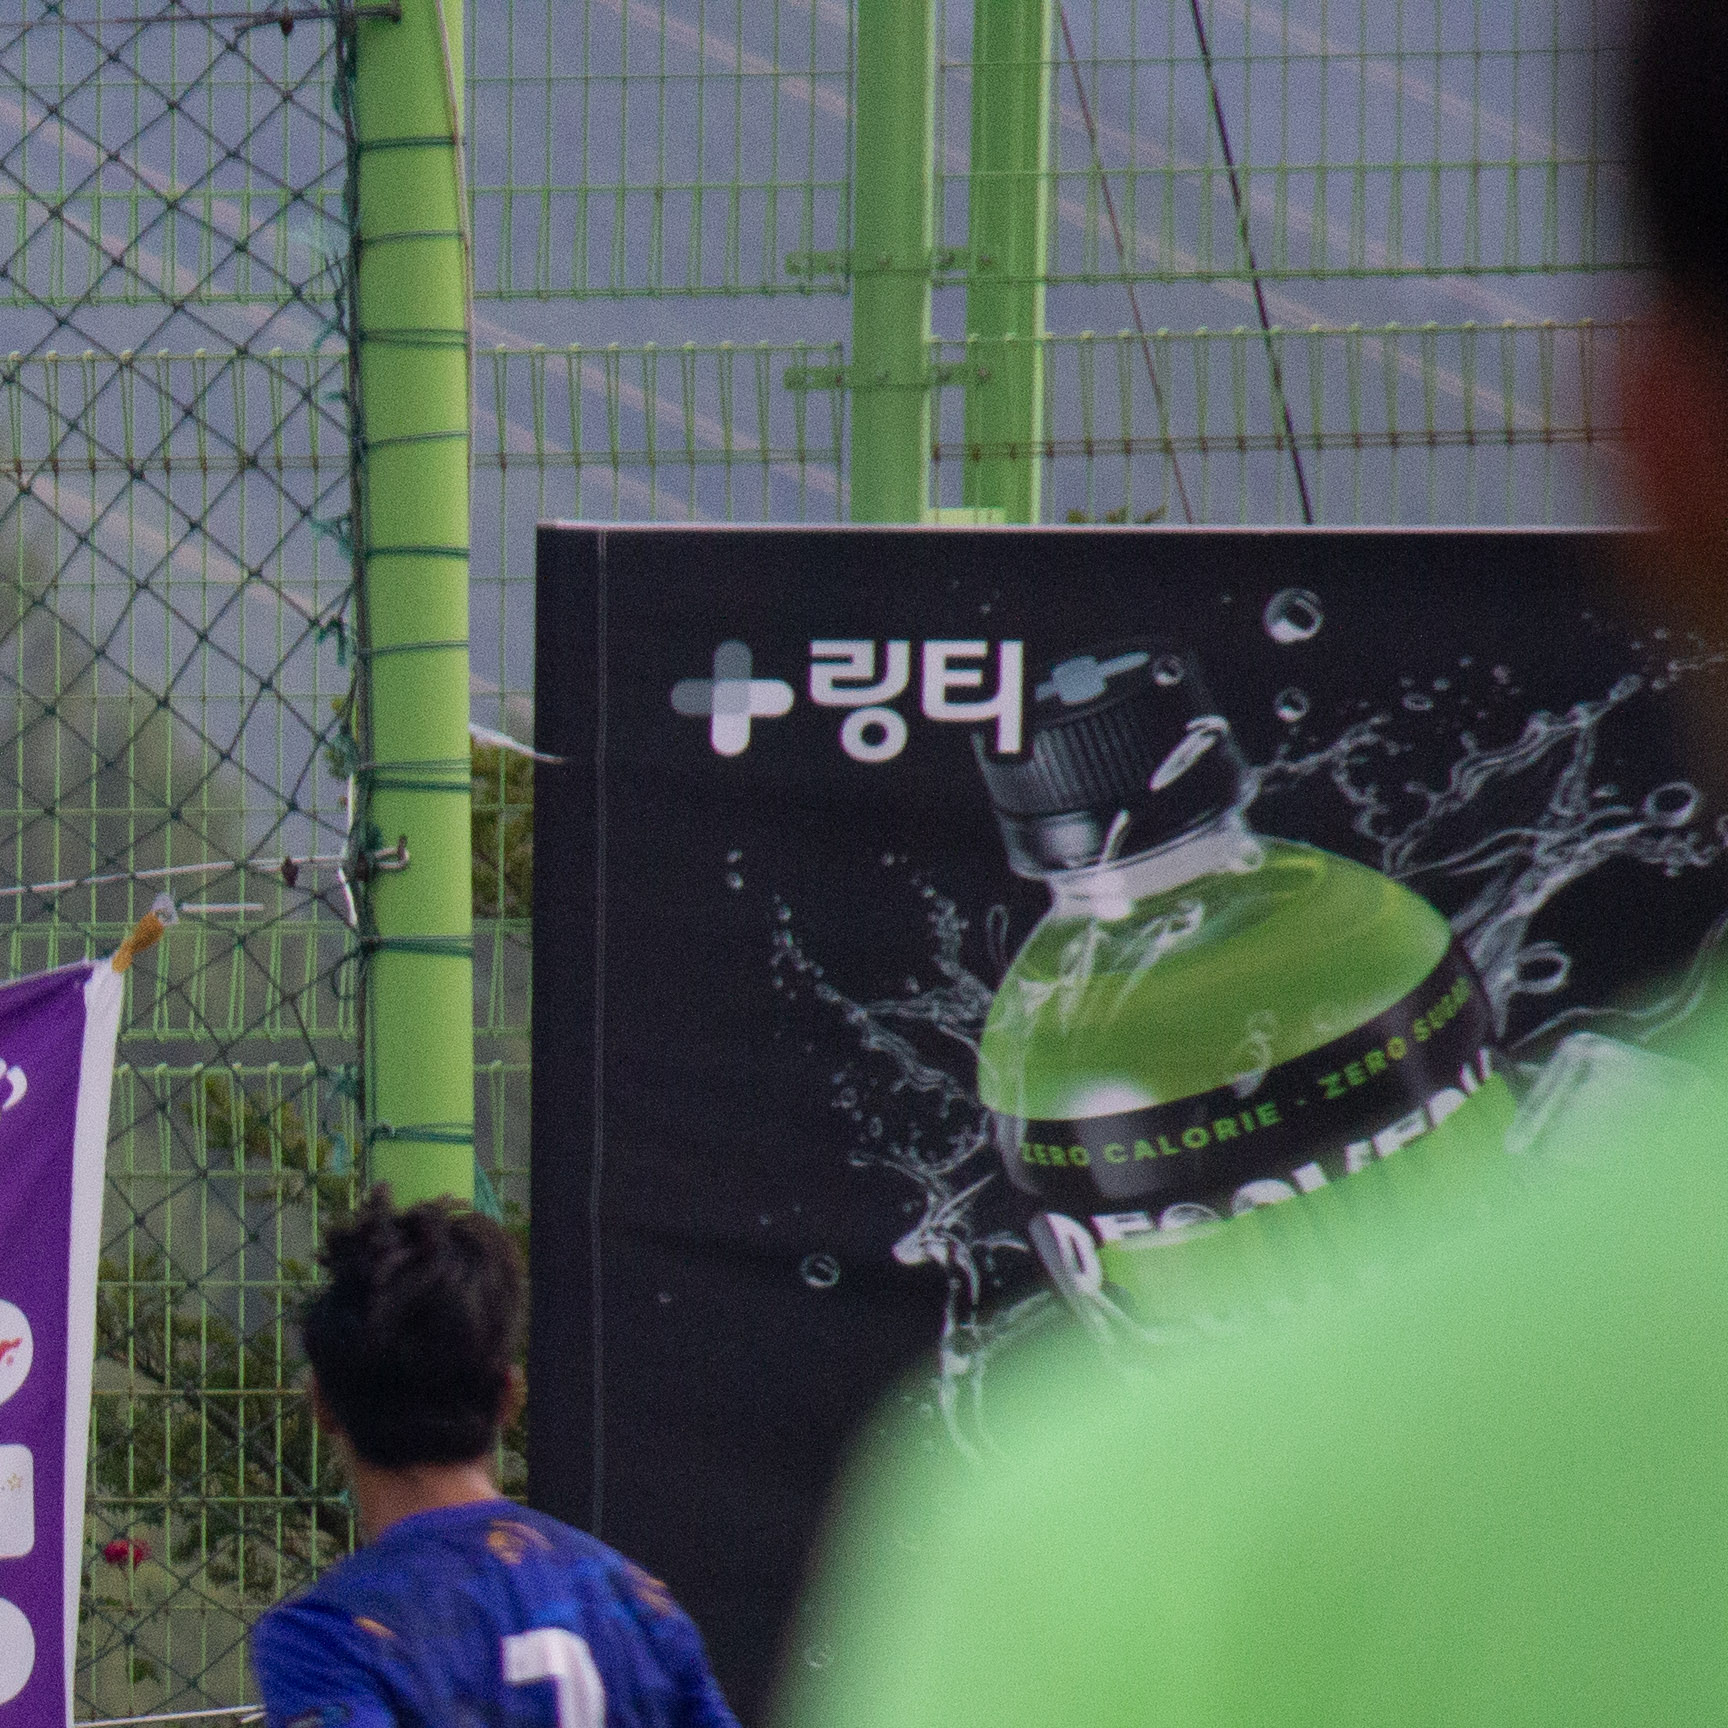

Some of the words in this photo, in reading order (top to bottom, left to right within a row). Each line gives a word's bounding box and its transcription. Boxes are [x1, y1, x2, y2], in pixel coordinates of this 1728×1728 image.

[808, 640, 1024, 763] 링티
[1020, 1141, 1090, 1169] ZERO
[1102, 1099, 1284, 1166] CALORIE
[1317, 1036, 1408, 1100] ZERO
